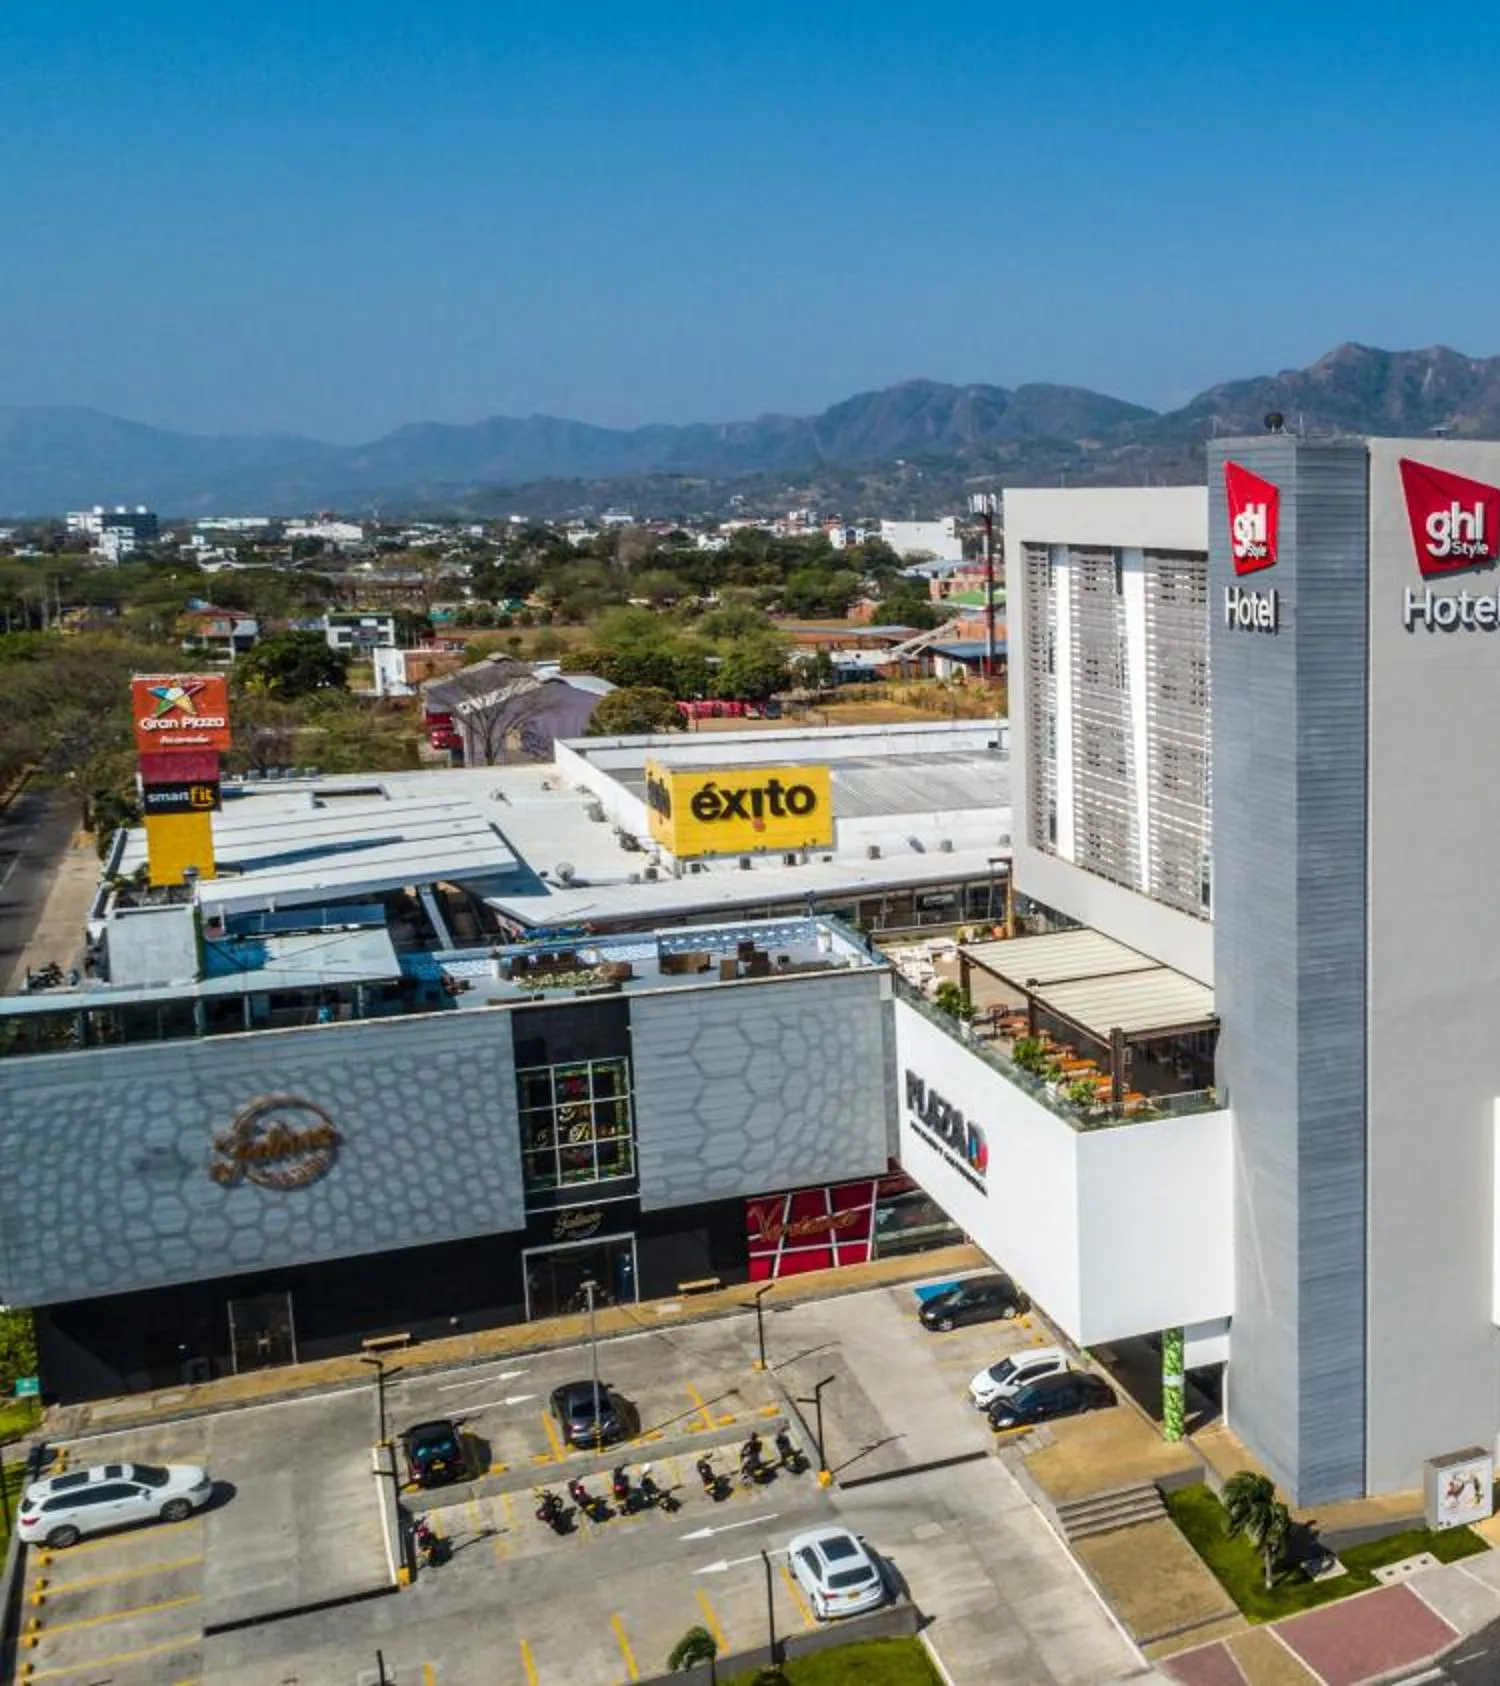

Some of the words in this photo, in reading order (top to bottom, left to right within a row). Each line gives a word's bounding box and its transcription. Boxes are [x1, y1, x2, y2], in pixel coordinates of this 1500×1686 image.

[1425, 500, 1484, 557] ghl
[1451, 541, 1490, 559] Style
[1225, 585, 1275, 628] Hotel
[139, 717, 179, 731] Gran
[181, 715, 225, 729] Plaza
[689, 779, 817, 834] éxito
[905, 1068, 968, 1161] PLAZA
